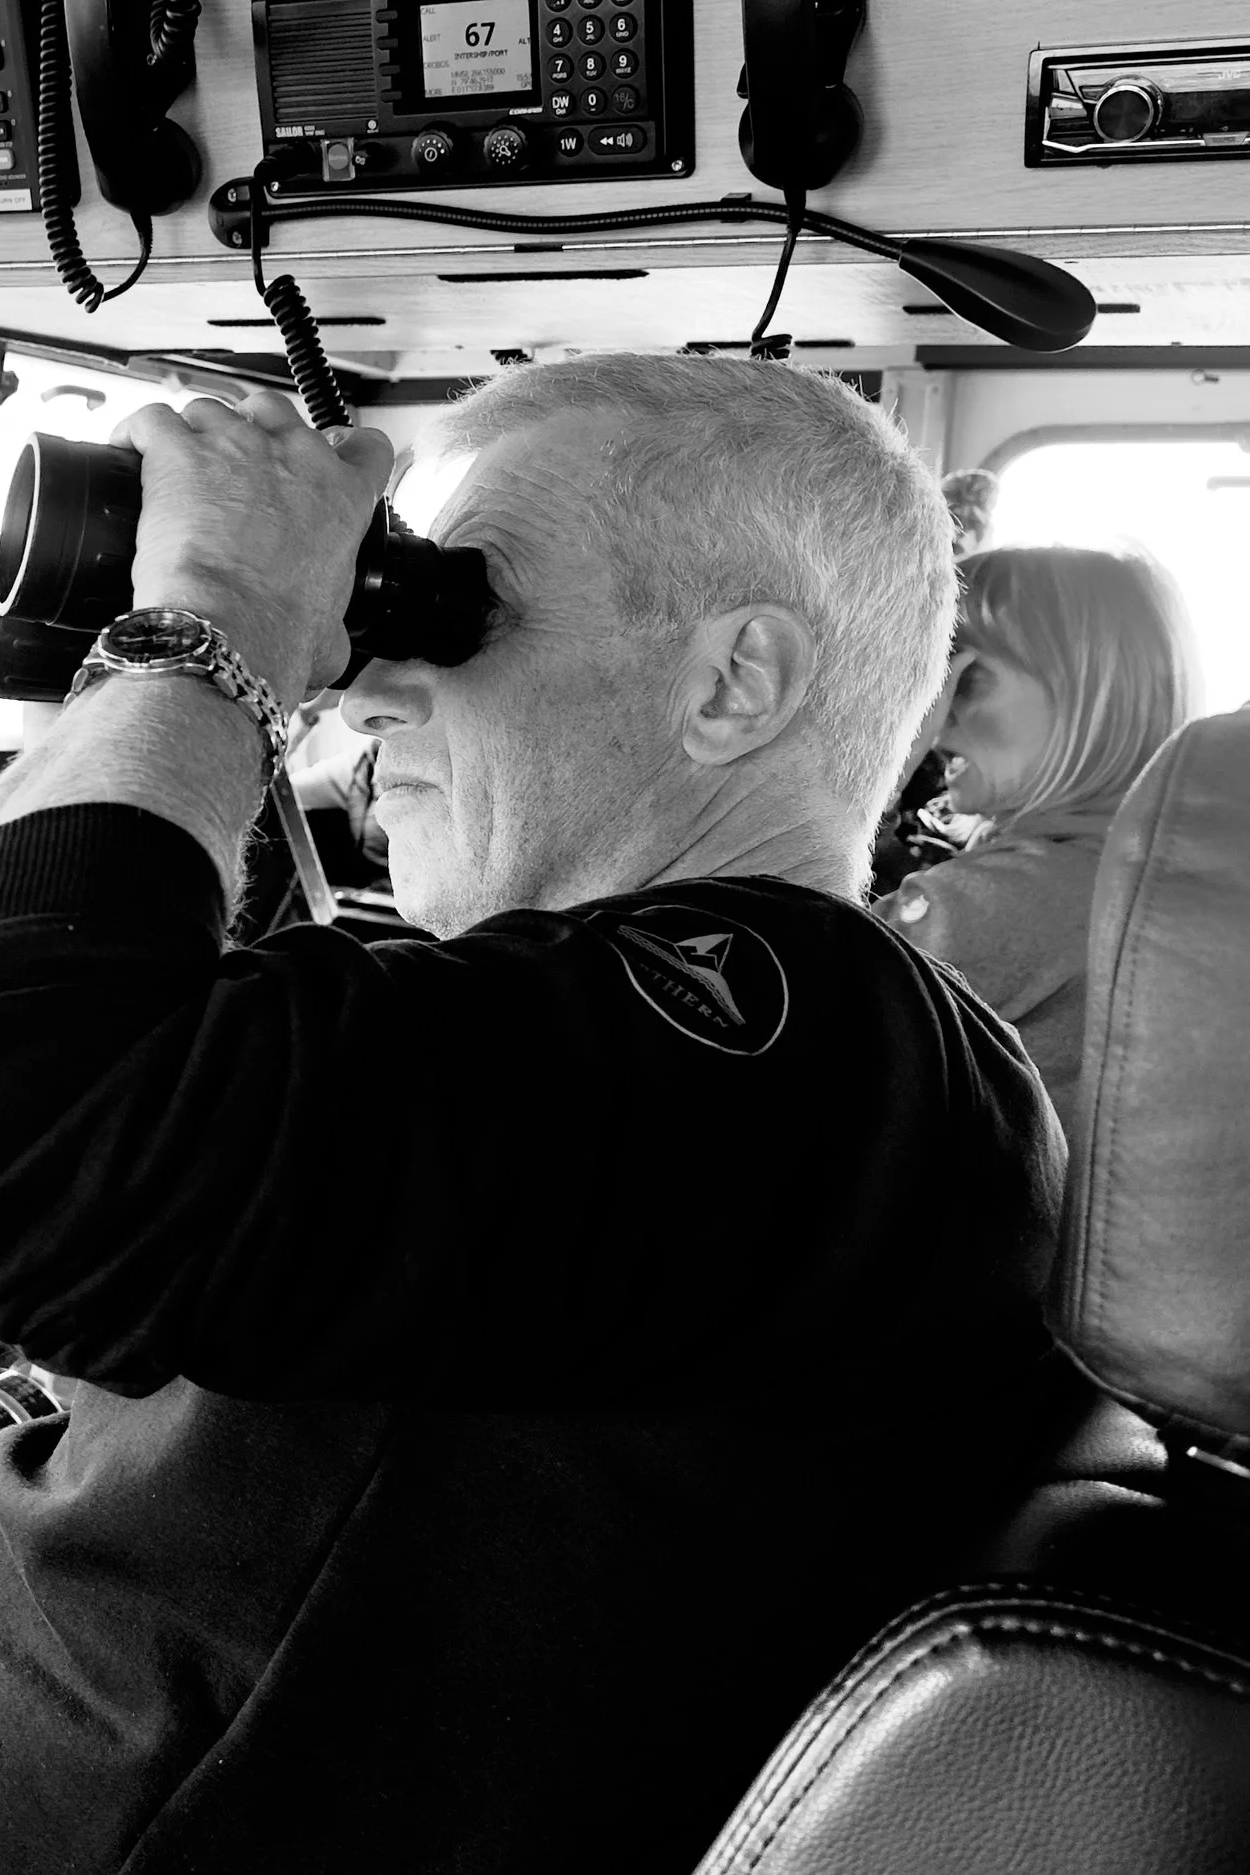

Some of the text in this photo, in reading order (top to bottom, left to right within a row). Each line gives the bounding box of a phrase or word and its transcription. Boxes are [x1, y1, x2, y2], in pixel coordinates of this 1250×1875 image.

[553, 24, 561, 35] 4
[586, 21, 594, 33] 5
[617, 19, 626, 31] 6
[465, 22, 496, 47] 67
[555, 60, 563, 72] 7
[586, 58, 595, 70] 8
[619, 55, 627, 67] 9
[552, 96, 569, 108] DW
[588, 94, 596, 105] 0
[275, 126, 304, 138] SAILOR
[560, 137, 576, 150] 1W
